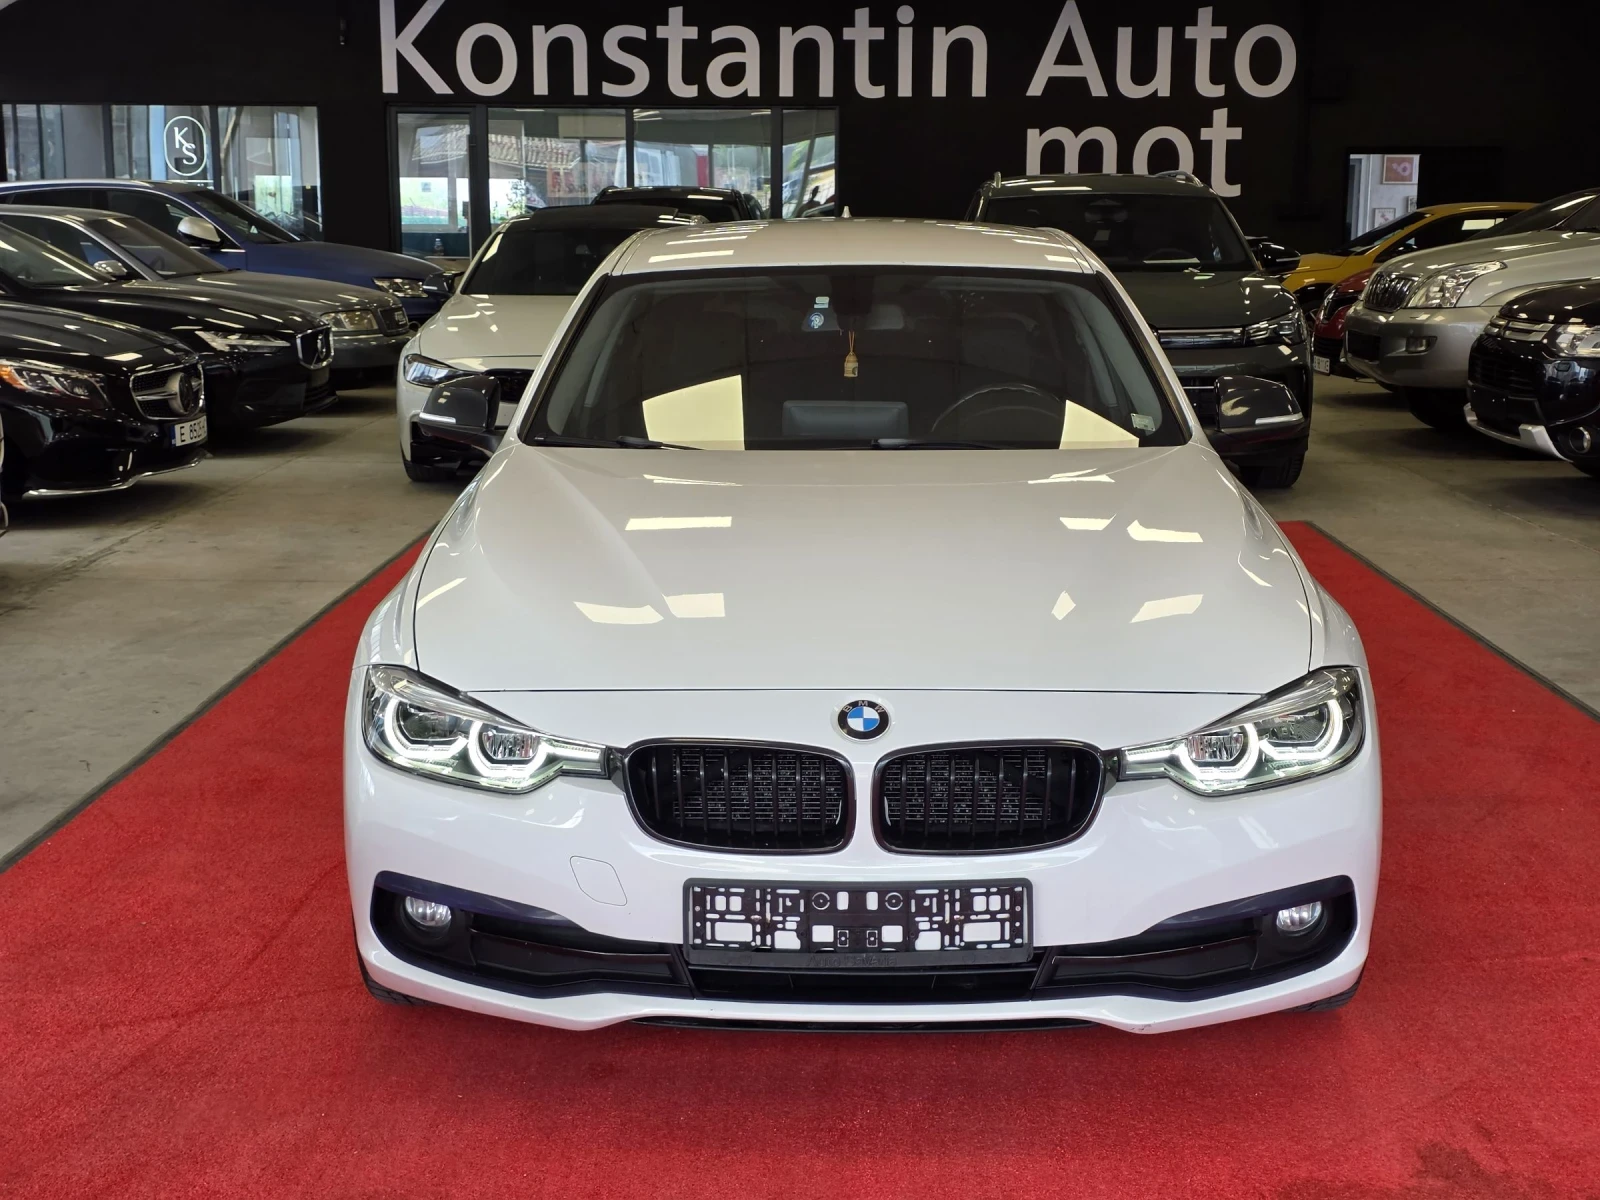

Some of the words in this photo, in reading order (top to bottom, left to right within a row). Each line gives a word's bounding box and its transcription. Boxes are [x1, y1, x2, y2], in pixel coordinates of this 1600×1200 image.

[380, 0, 988, 98] Konstantin
[1026, 0, 1297, 98] Auto
[1026, 108, 1242, 198] mot
[842, 700, 885, 712] BMW
